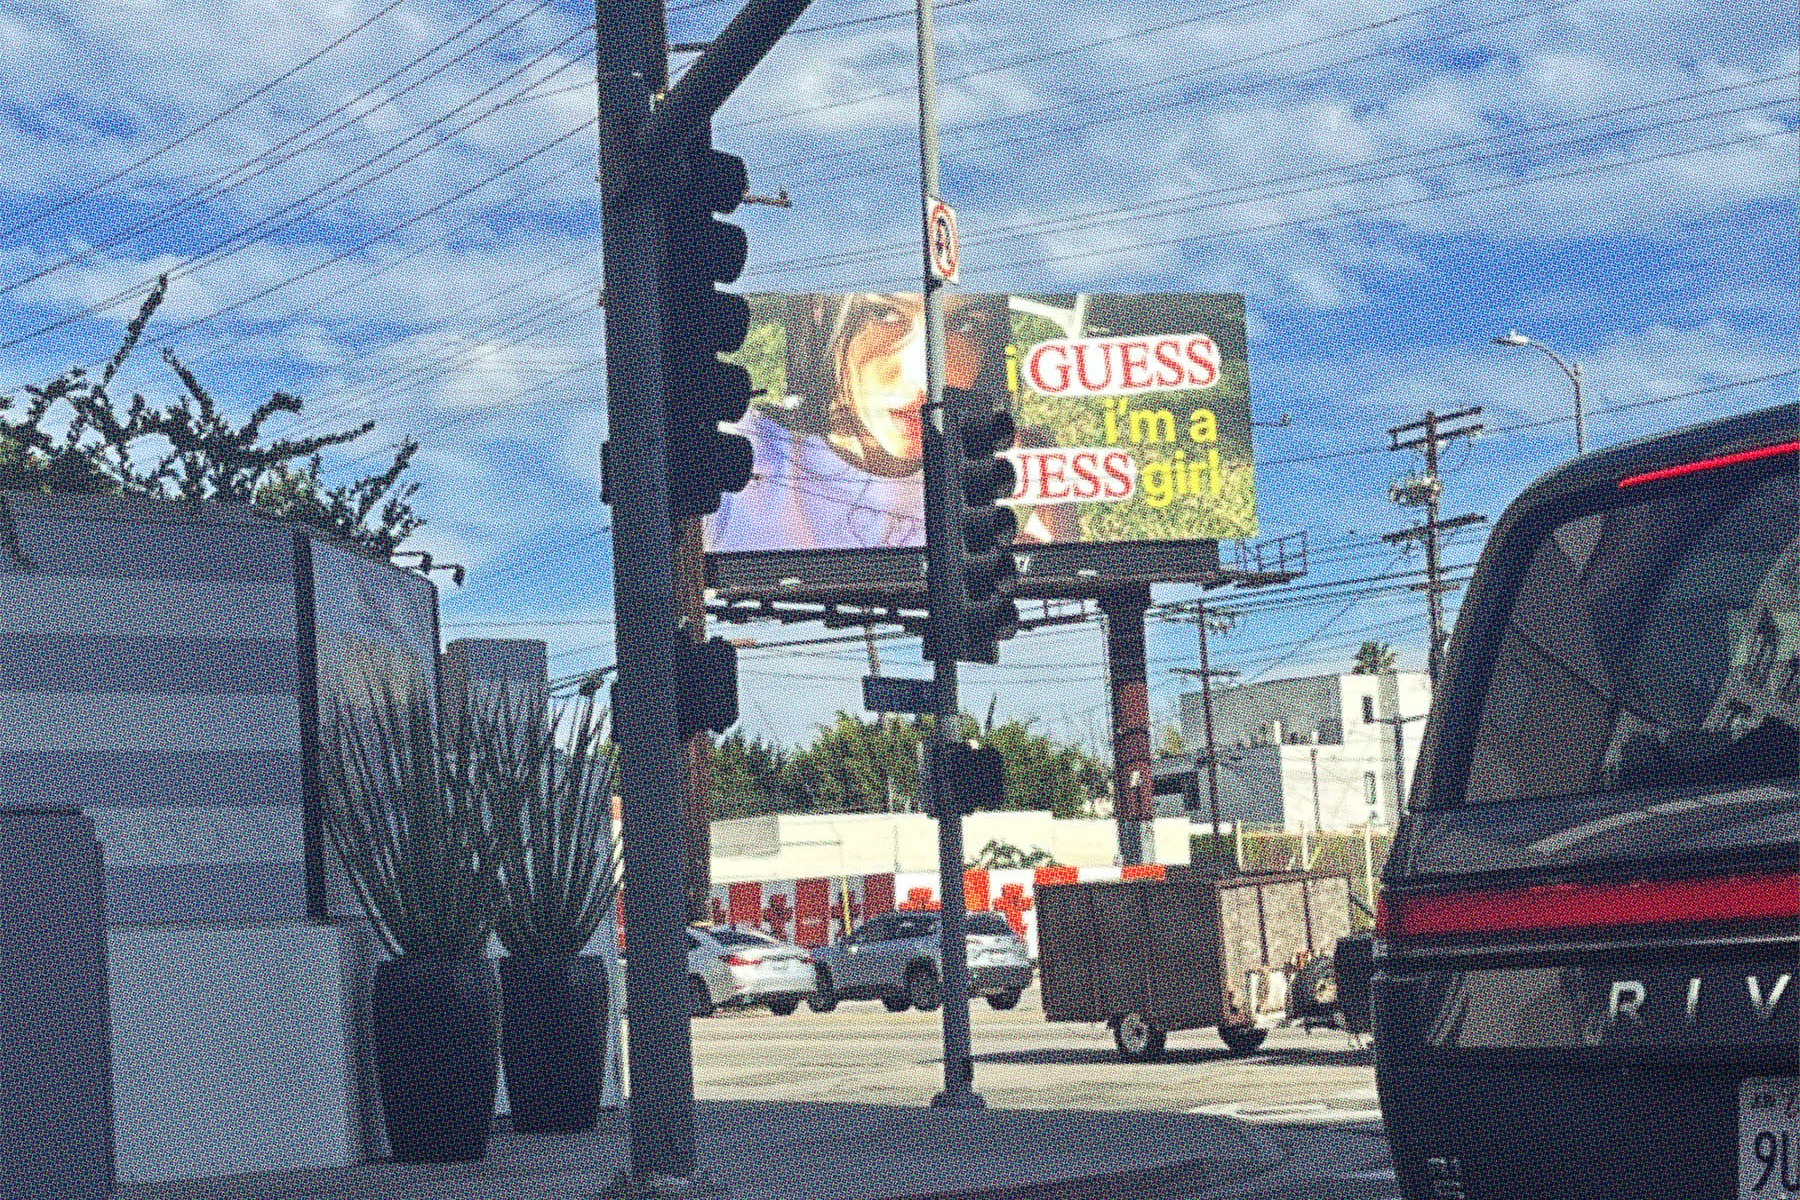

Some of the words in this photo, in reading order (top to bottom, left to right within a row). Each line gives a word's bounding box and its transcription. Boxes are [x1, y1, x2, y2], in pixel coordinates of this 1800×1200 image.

[1005, 344, 1018, 391] i
[1030, 338, 1218, 393] GUESS
[1104, 398, 1176, 444] i'm
[1189, 407, 1218, 443] a
[1012, 452, 1133, 500] ESS
[1142, 449, 1221, 508] girl
[1608, 973, 1791, 1024] RIV
